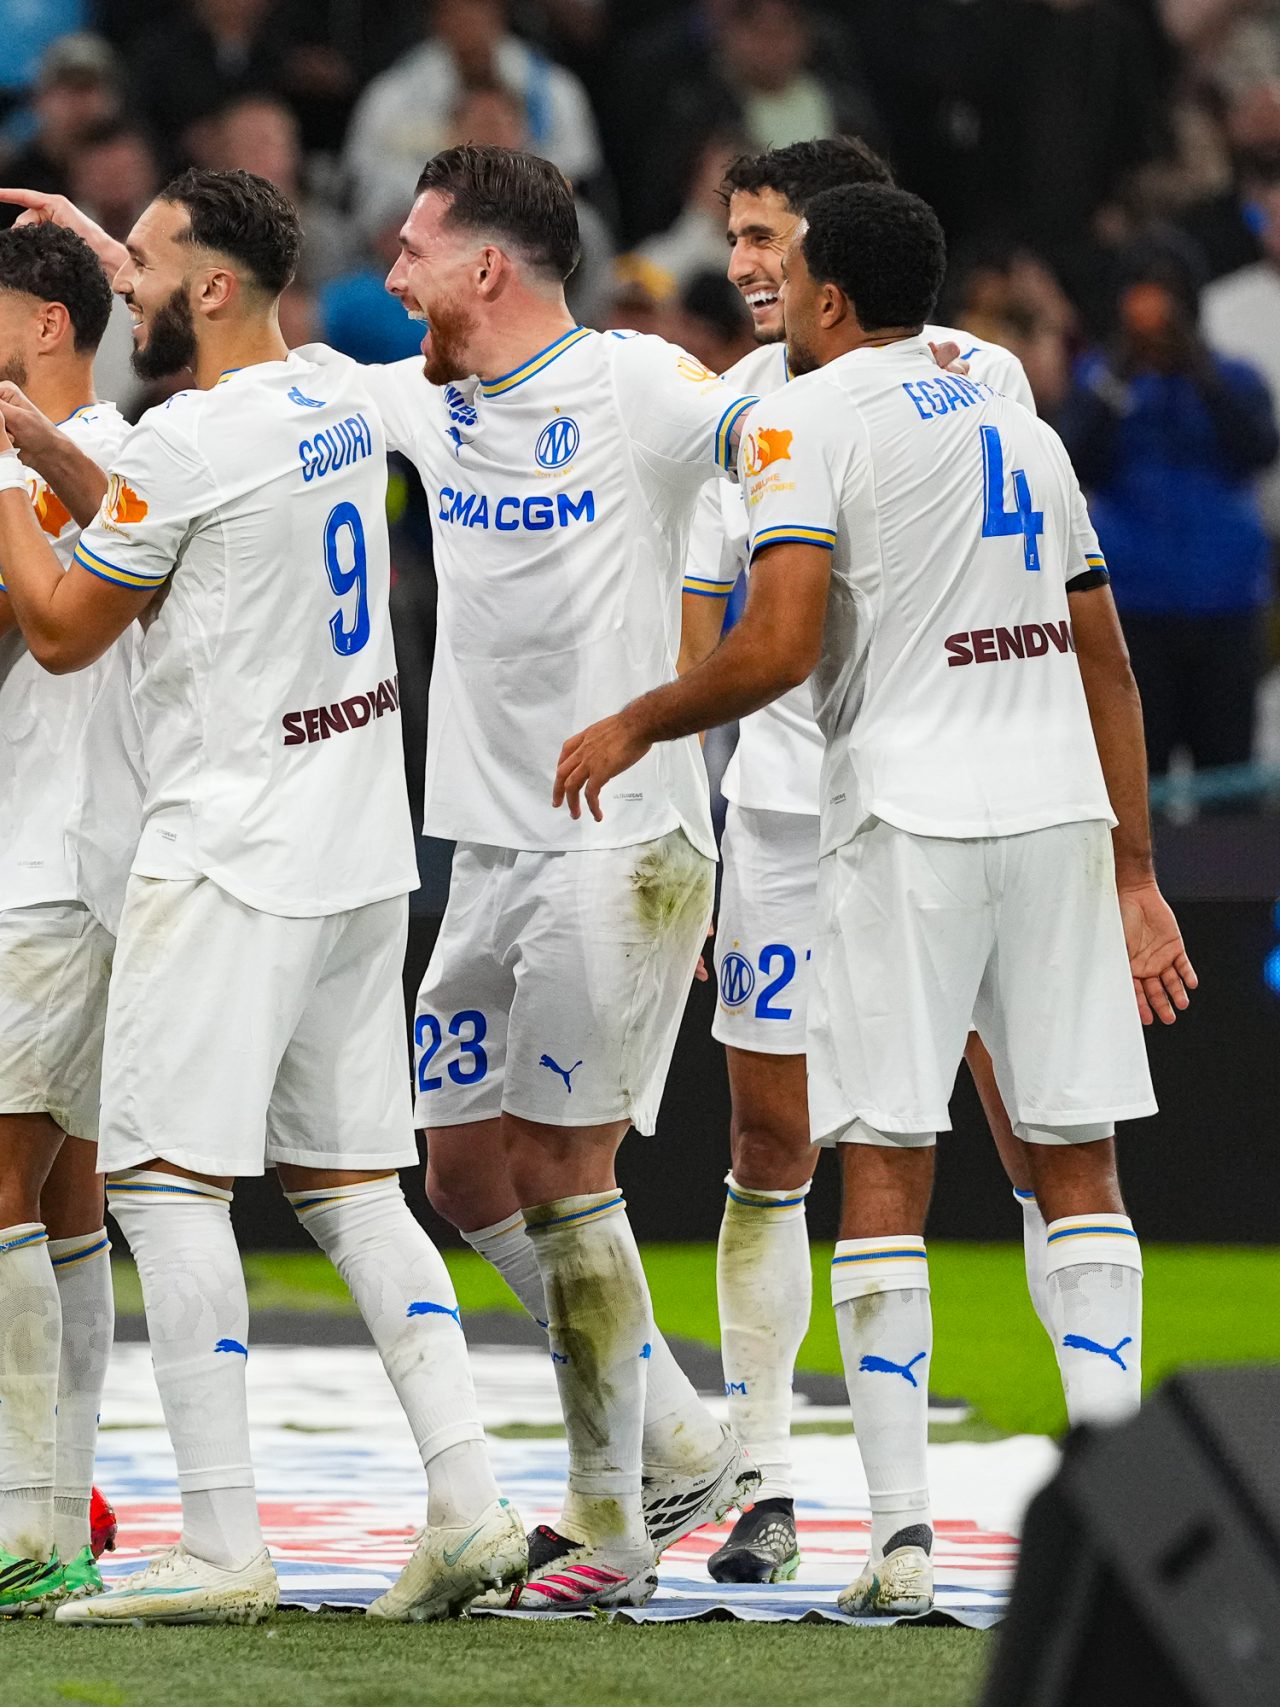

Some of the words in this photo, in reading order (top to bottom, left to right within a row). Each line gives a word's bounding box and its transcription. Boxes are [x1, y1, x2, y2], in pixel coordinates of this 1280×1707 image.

[902, 375, 1006, 420] EGAN
[298, 413, 372, 482] GOUIRI
[439, 487, 489, 529] CMA
[495, 490, 595, 531] CGM
[980, 425, 1044, 571] 4
[323, 501, 370, 656] 9
[755, 944, 811, 1020] 2
[415, 1010, 488, 1093] 23
